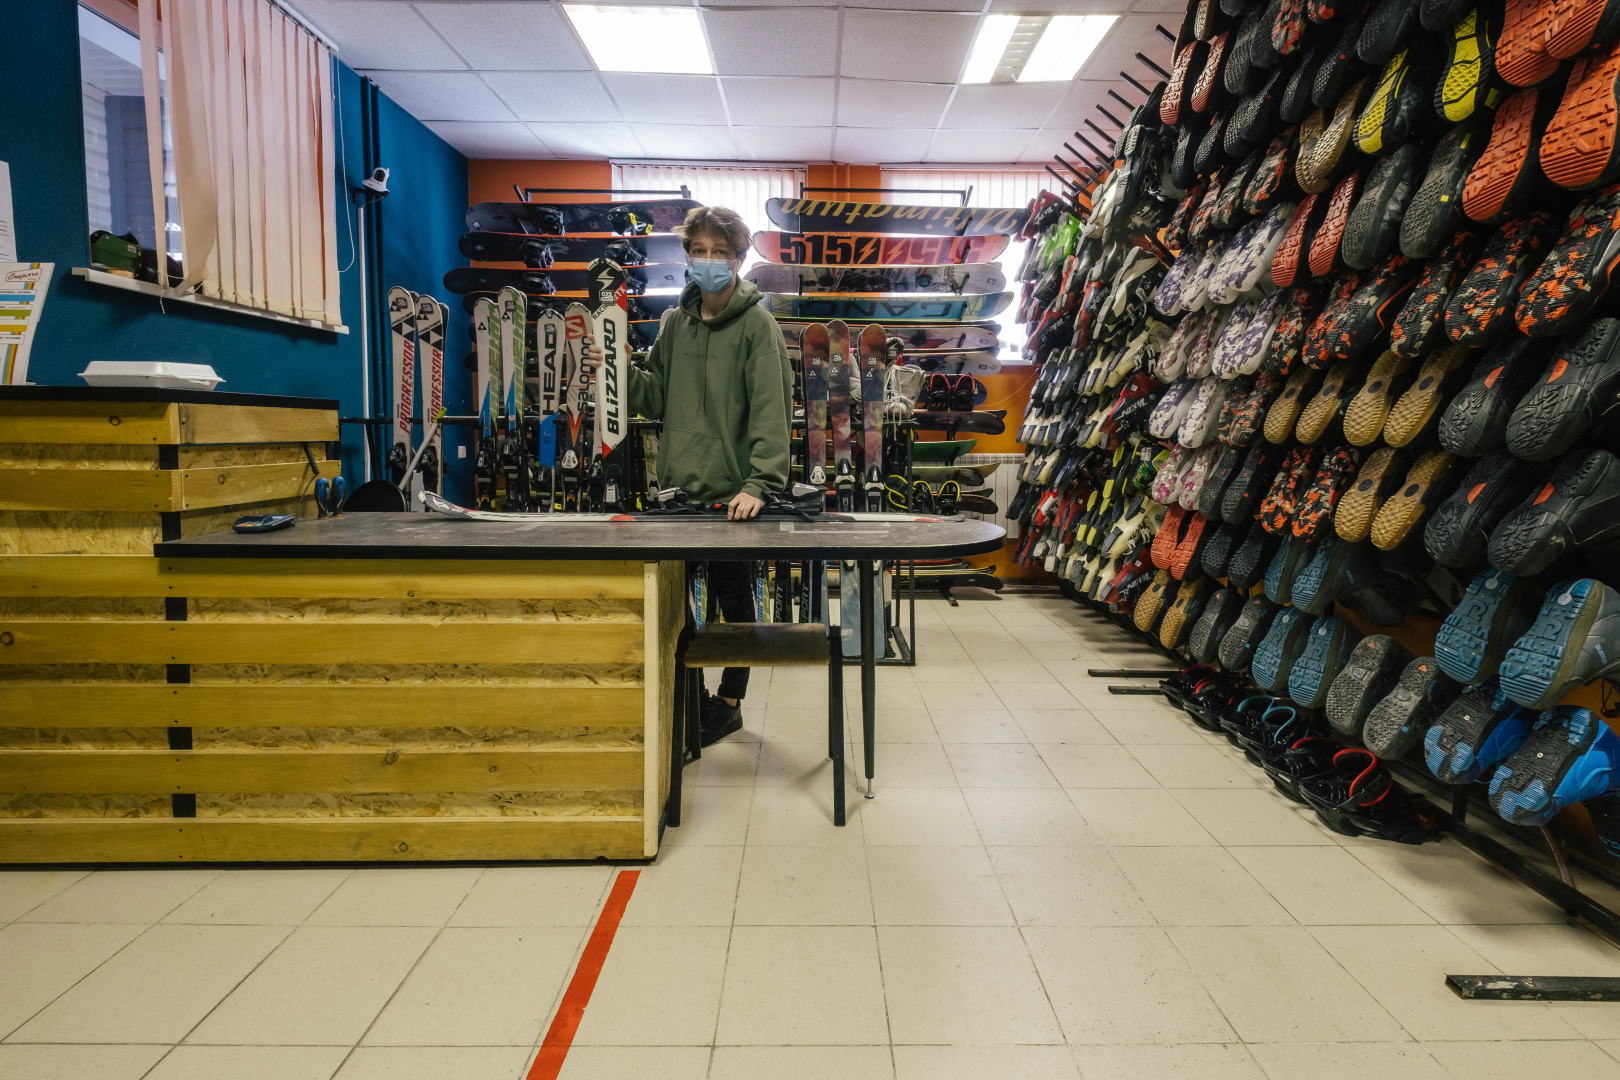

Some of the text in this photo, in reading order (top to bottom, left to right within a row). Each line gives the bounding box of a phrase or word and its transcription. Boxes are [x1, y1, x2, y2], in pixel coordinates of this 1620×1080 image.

[780, 198, 1018, 234] Ultimatum
[399, 339, 415, 434] PROGRESSOR
[542, 332, 558, 416] HEAD
